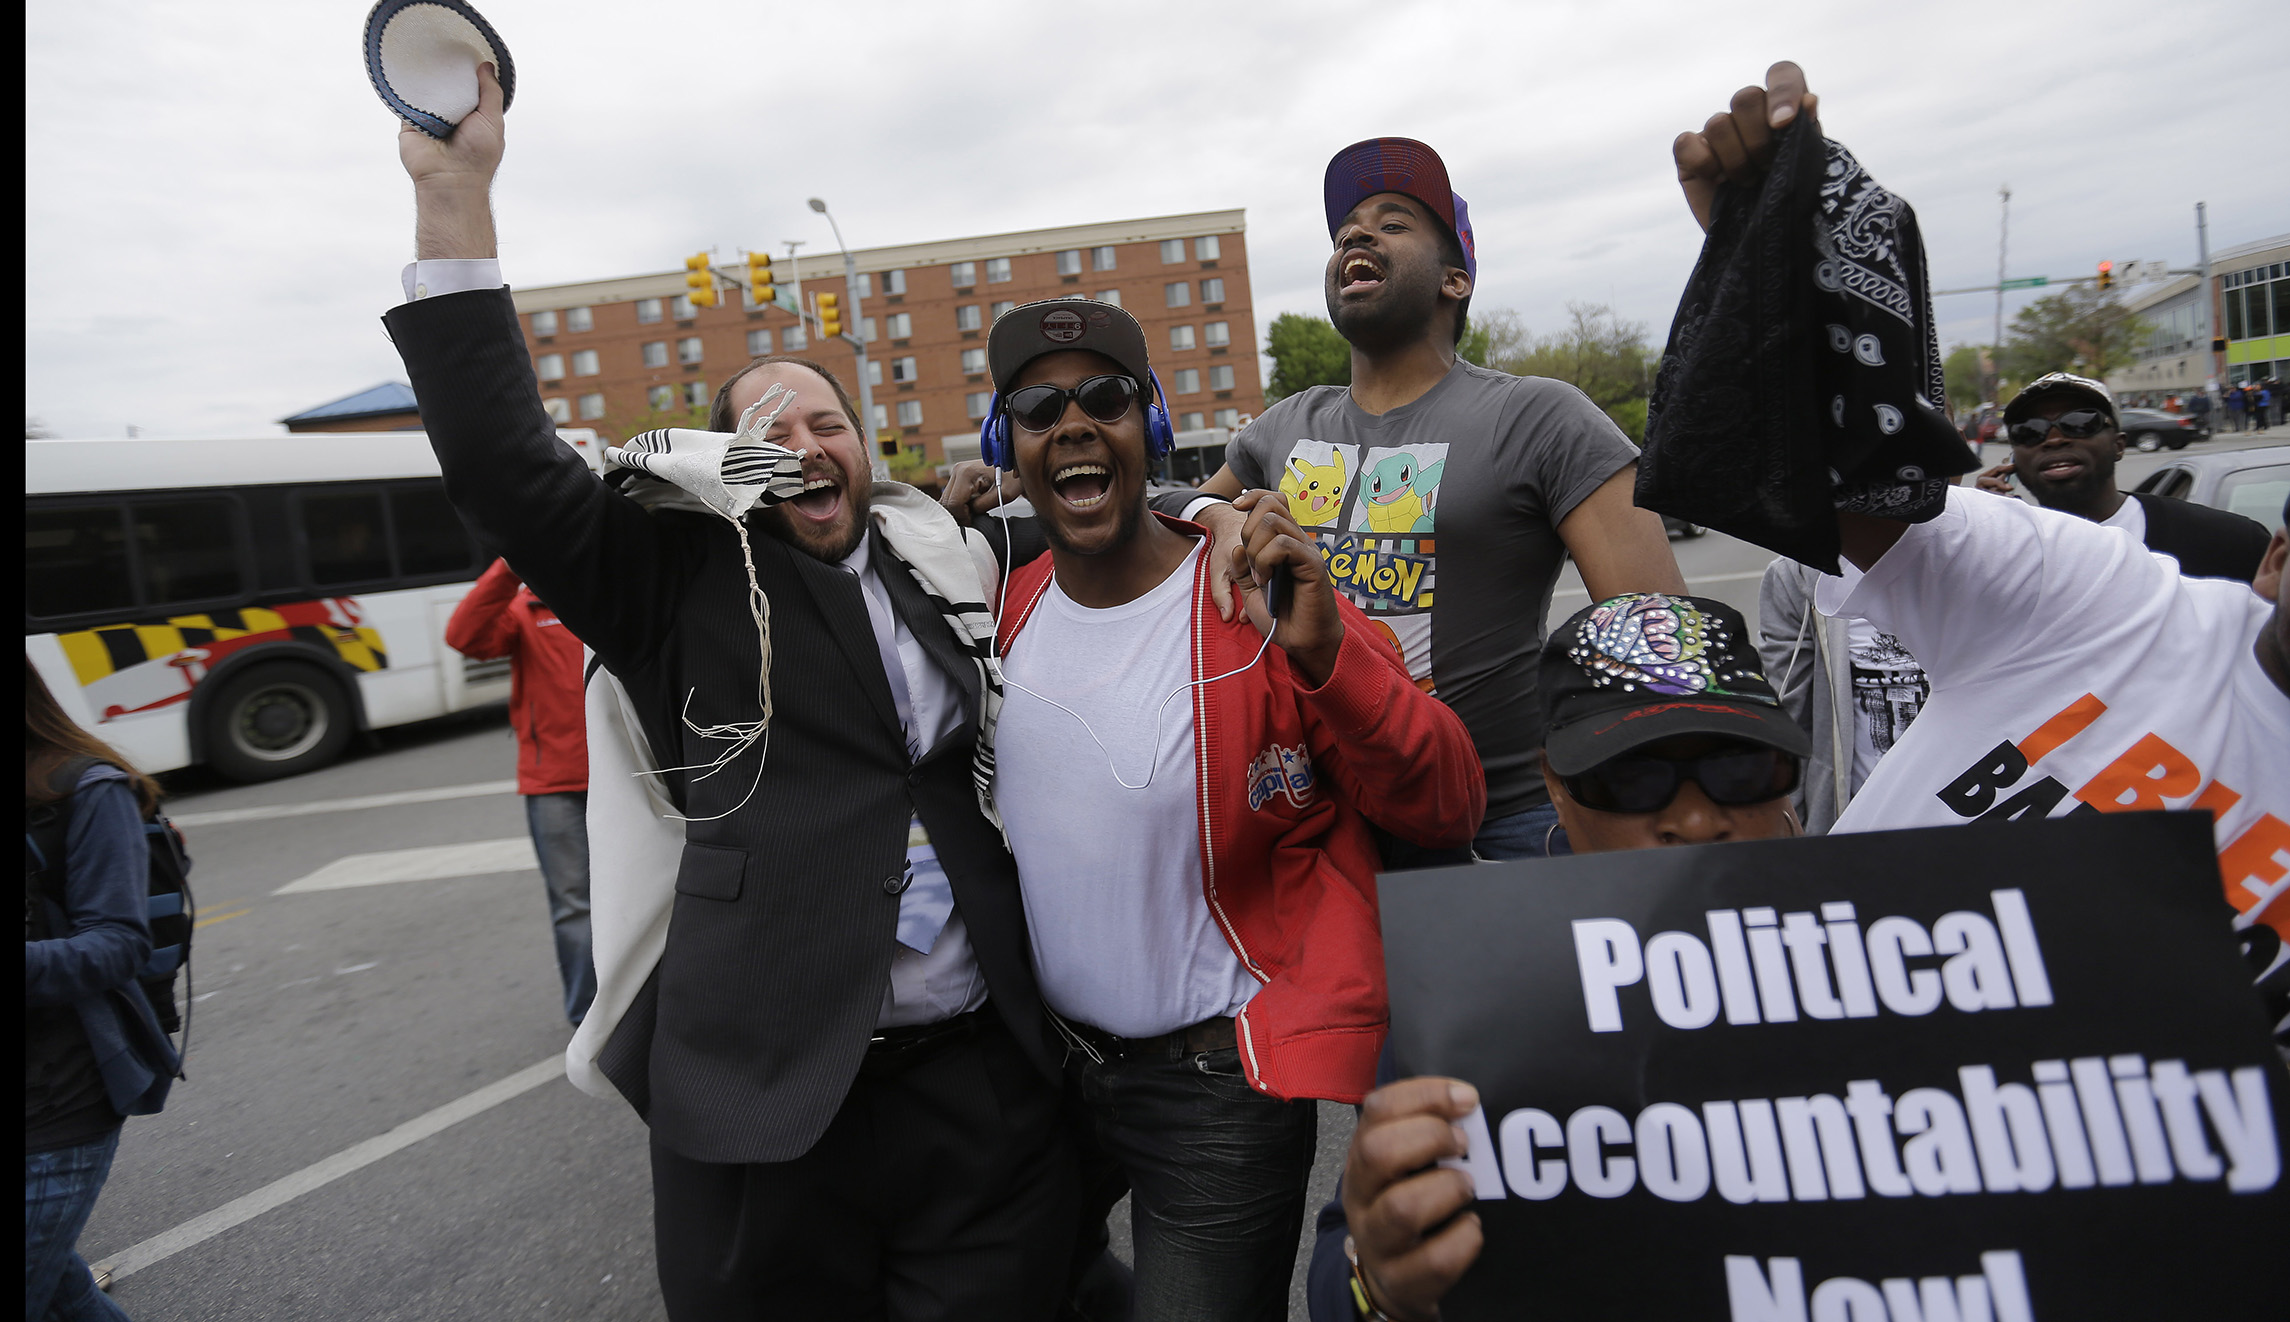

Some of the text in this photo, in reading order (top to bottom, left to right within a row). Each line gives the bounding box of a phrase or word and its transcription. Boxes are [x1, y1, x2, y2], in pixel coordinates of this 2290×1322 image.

[2017, 692, 2108, 767] I
[1572, 888, 2053, 1033] Political
[1437, 1055, 2282, 1203] Accountability
